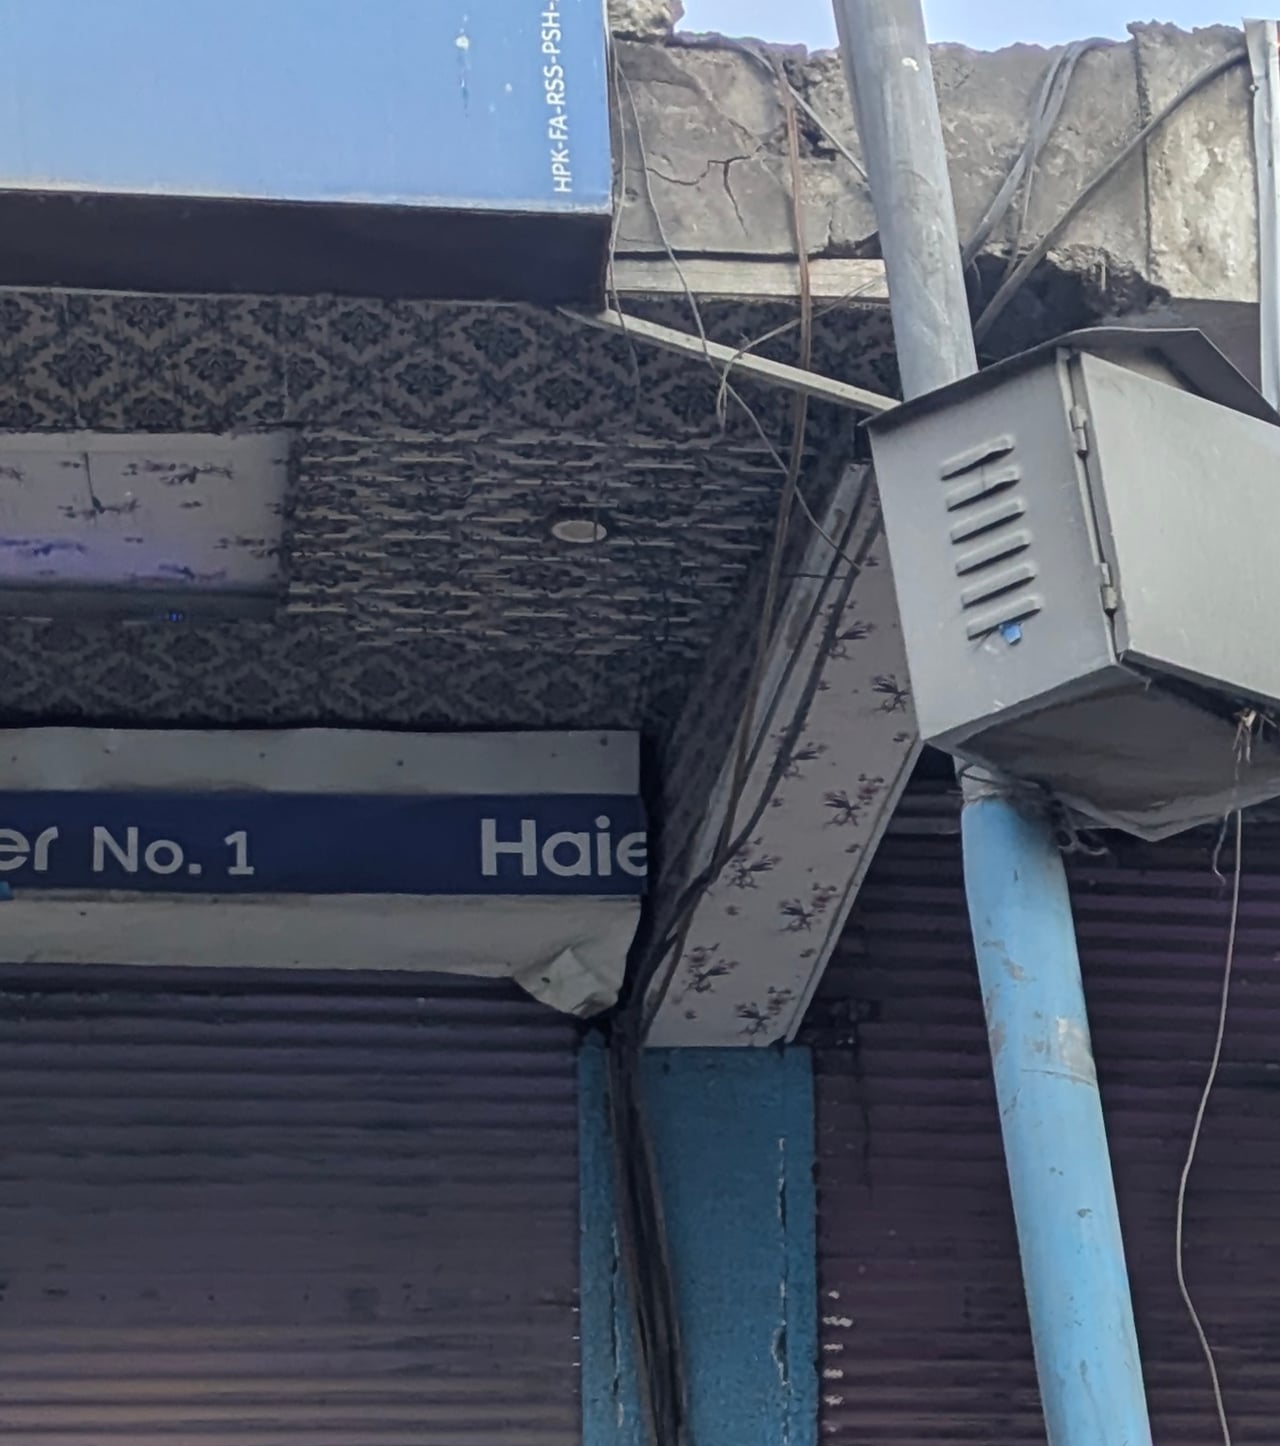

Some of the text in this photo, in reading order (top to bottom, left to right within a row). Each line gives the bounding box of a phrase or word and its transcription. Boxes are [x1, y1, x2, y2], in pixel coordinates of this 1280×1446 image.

[541, 0, 574, 192] HPK-FA-RSS-PSH-
[0, 826, 254, 875] er No. 1
[481, 815, 649, 877] Haie
